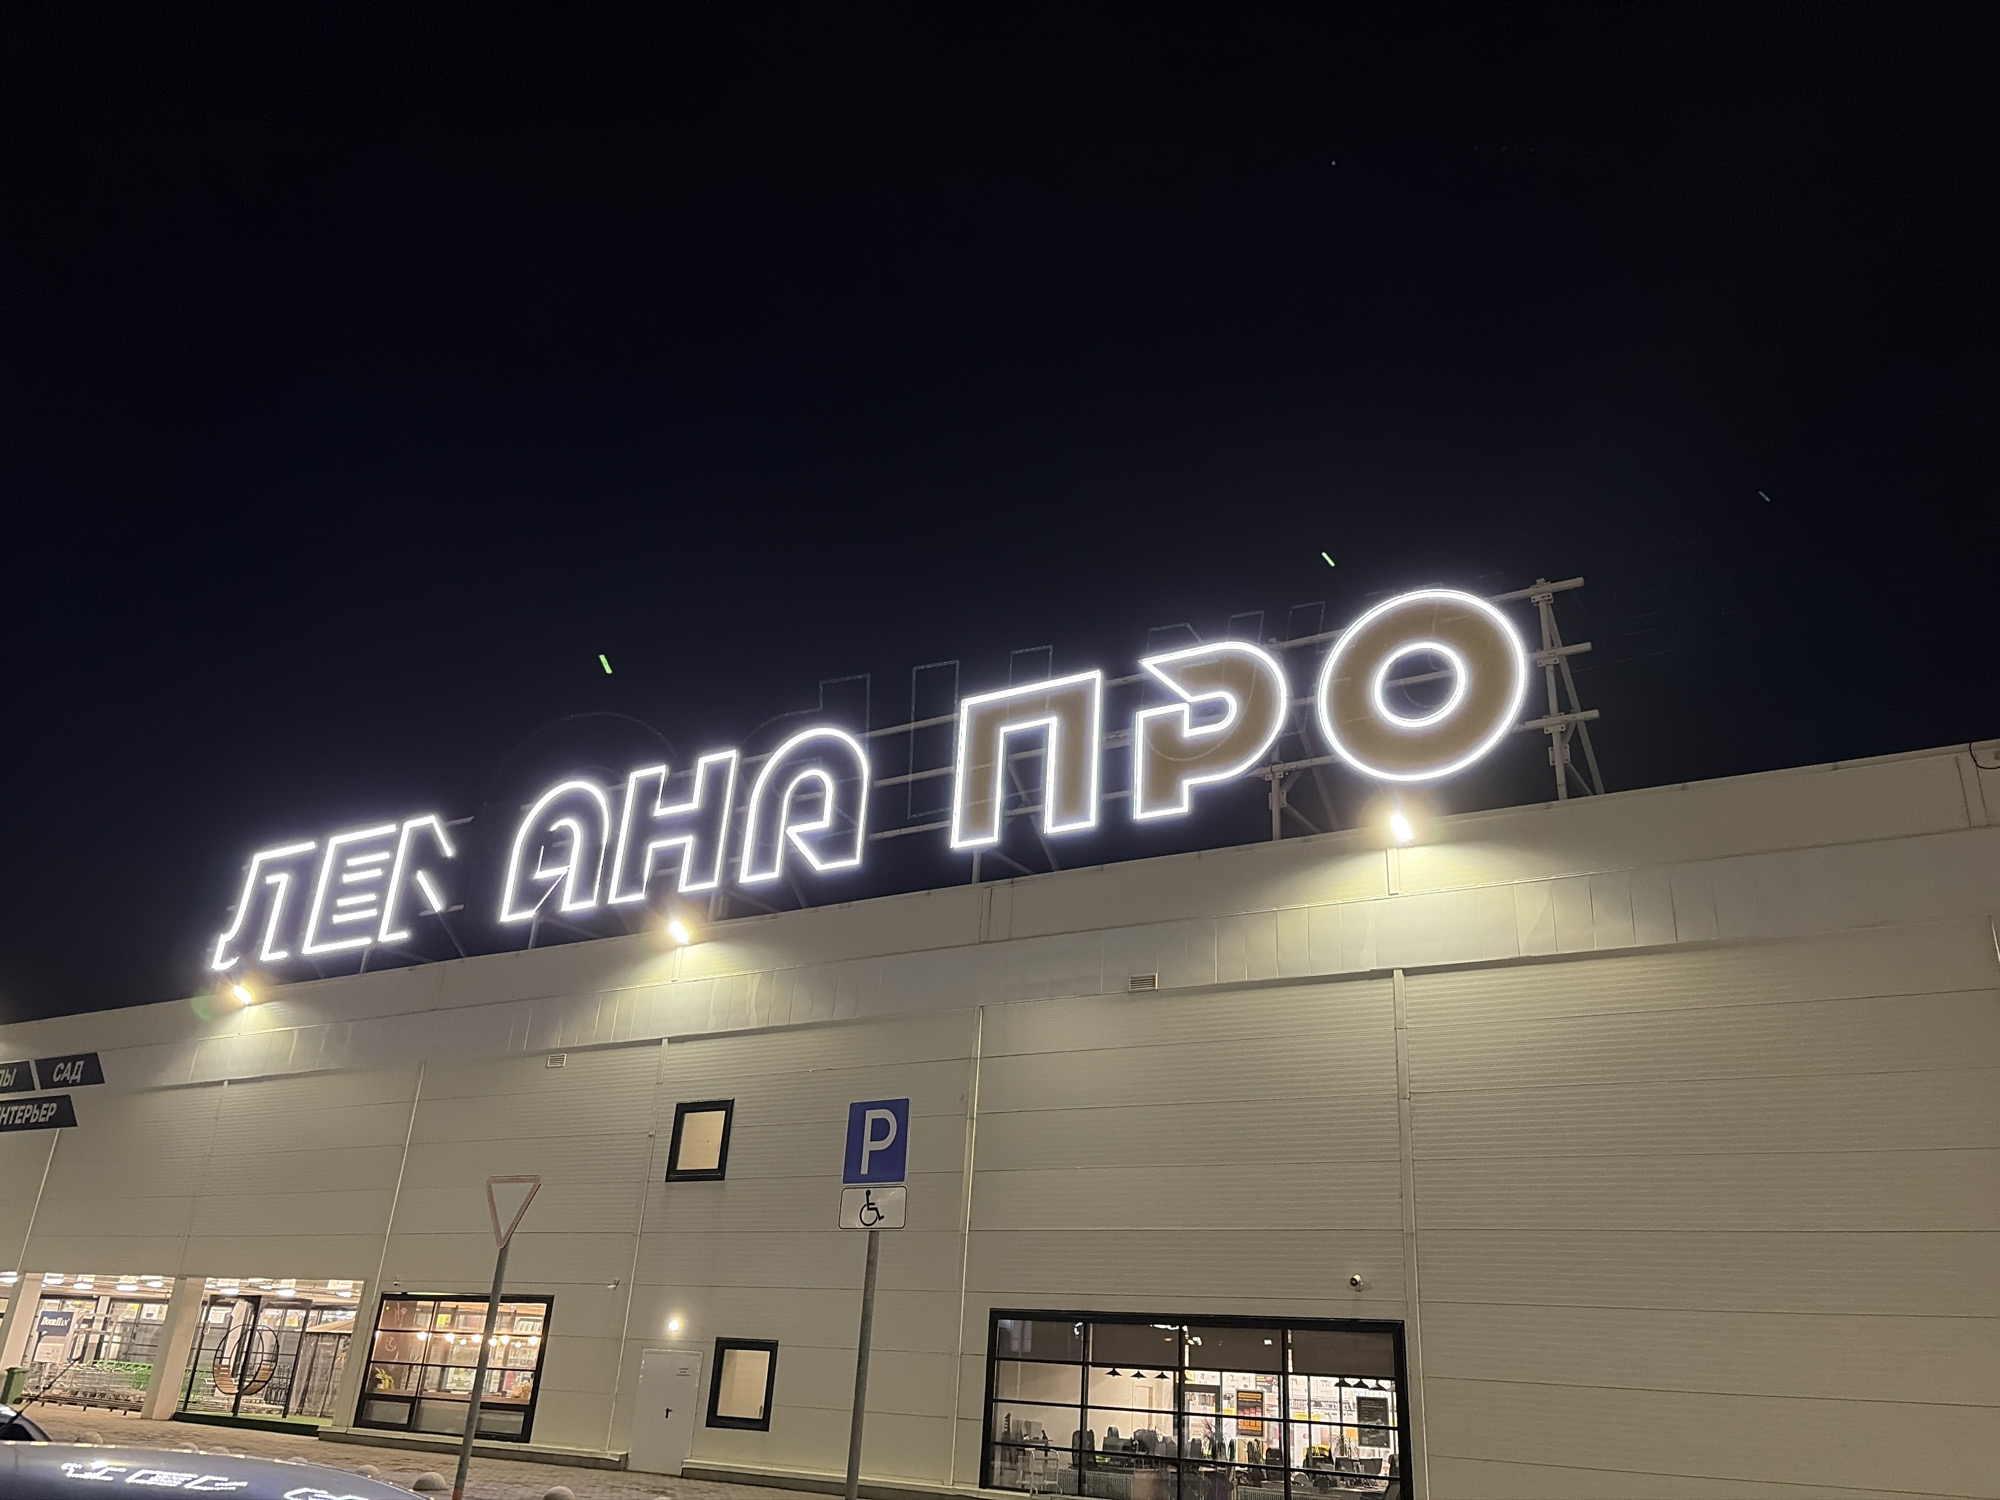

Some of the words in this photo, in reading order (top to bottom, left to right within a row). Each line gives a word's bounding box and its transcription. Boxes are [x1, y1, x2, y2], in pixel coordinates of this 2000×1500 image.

[950, 587, 1530, 850] ПРО
[53, 1060, 84, 1083] САД
[0, 1103, 57, 1125] НТЕРЬЕР
[861, 1109, 897, 1175] P
